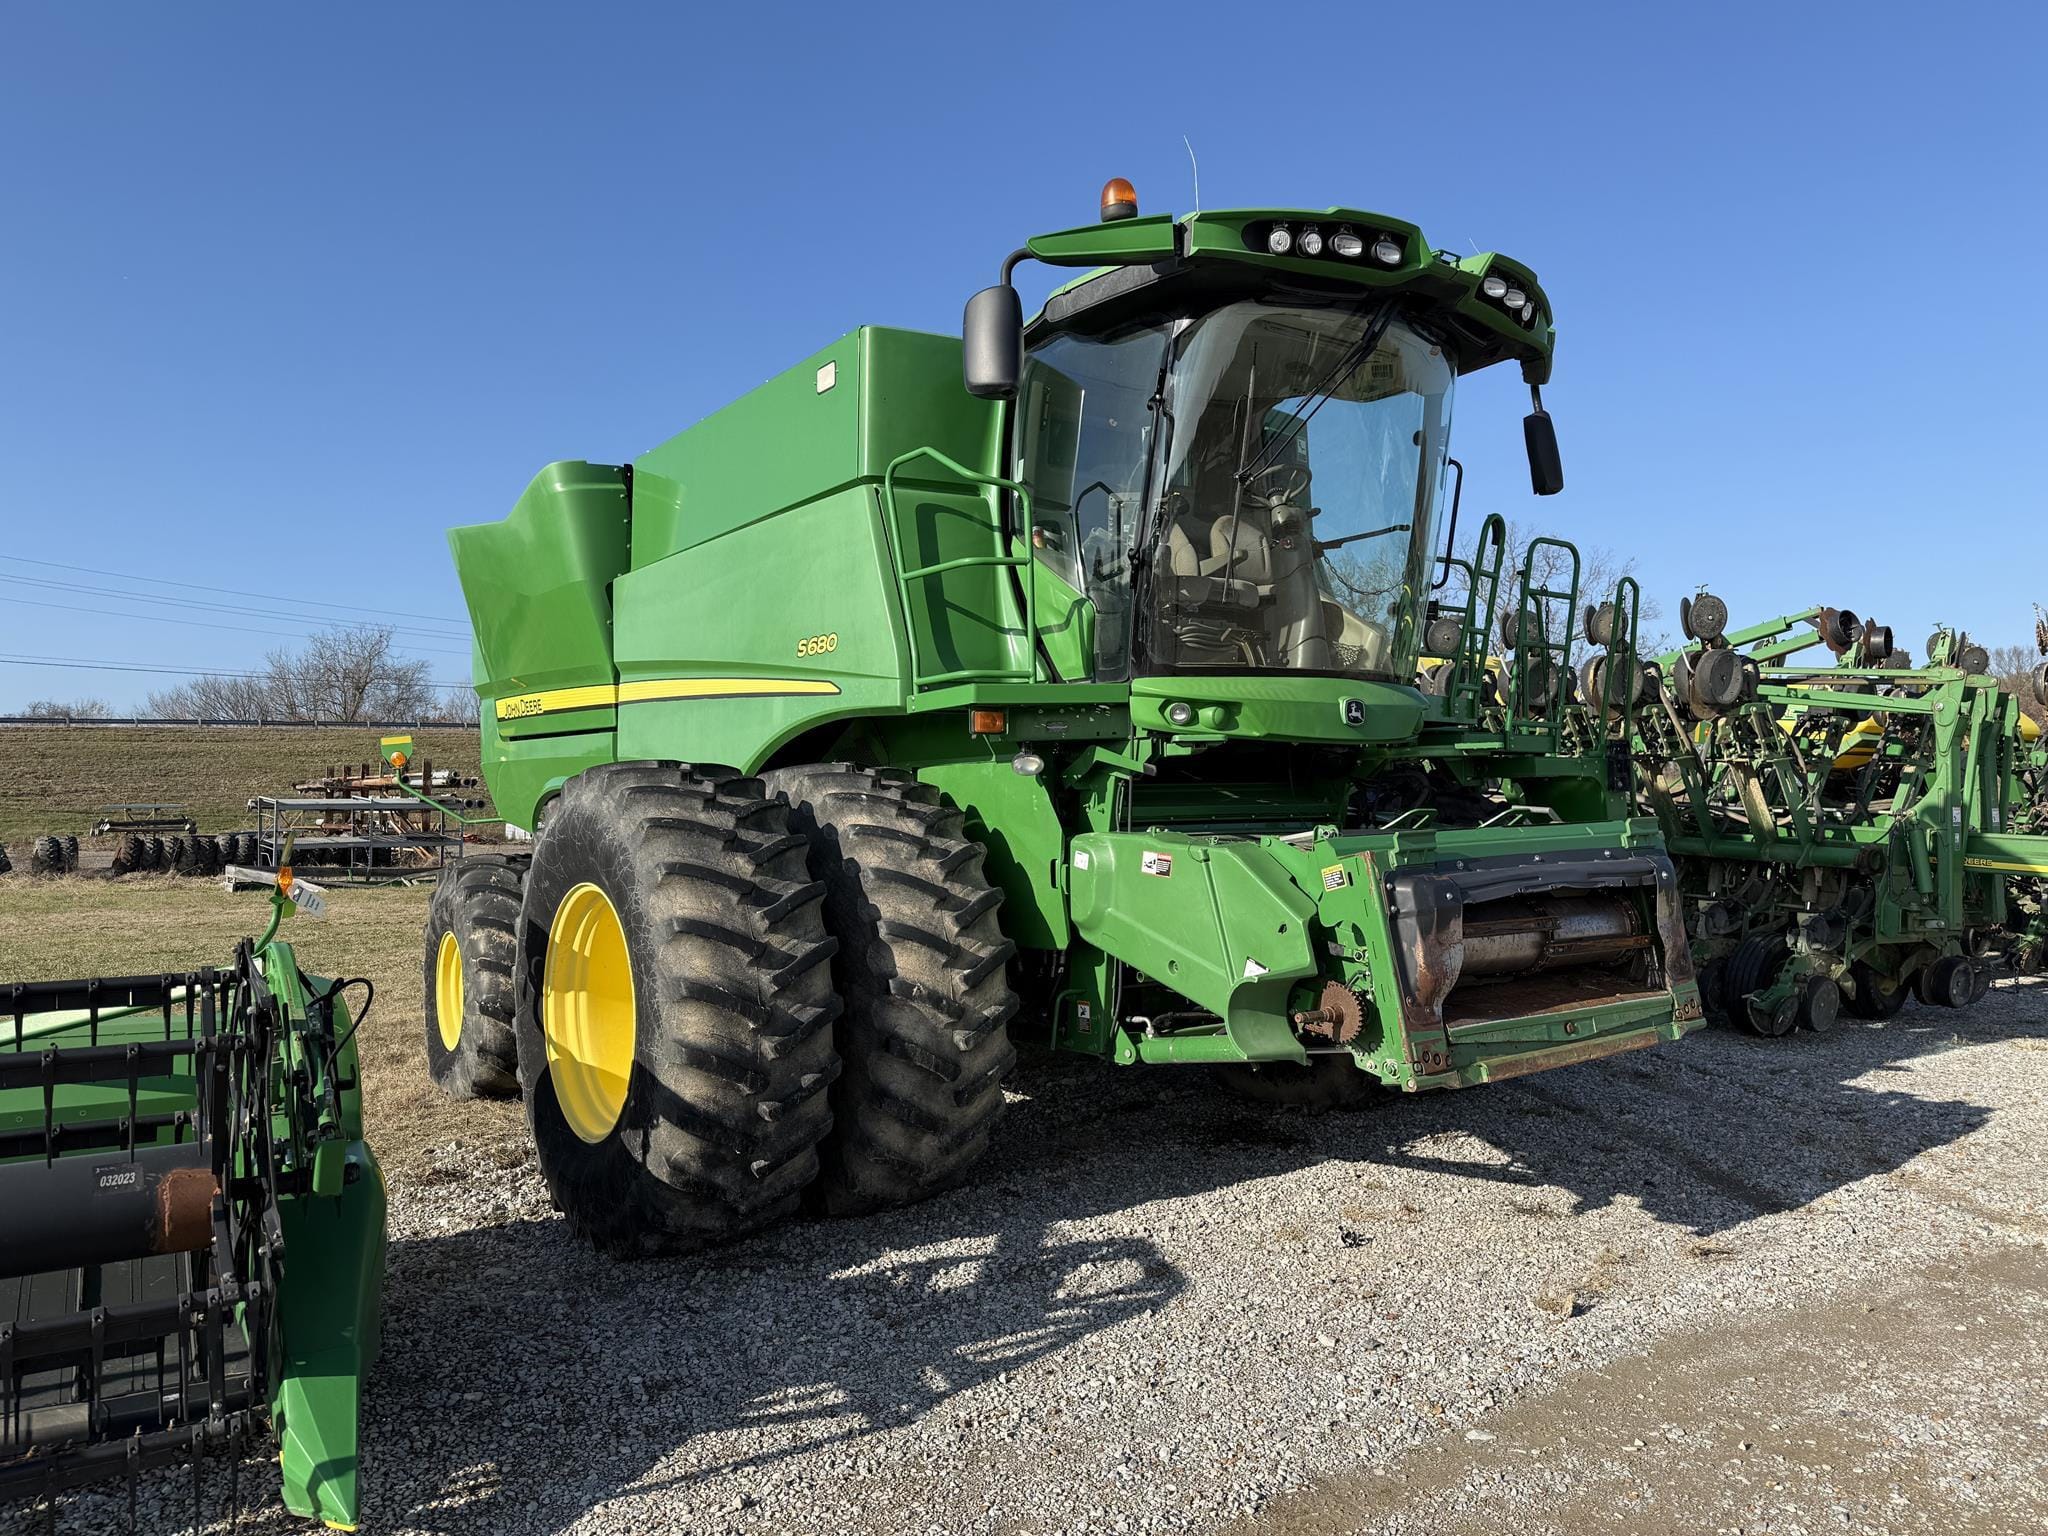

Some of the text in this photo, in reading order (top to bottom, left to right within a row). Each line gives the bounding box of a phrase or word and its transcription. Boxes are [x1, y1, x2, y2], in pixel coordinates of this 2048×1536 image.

[797, 632, 838, 658] S680
[520, 699, 543, 715] DEERE
[100, 1172, 135, 1187] 032023
